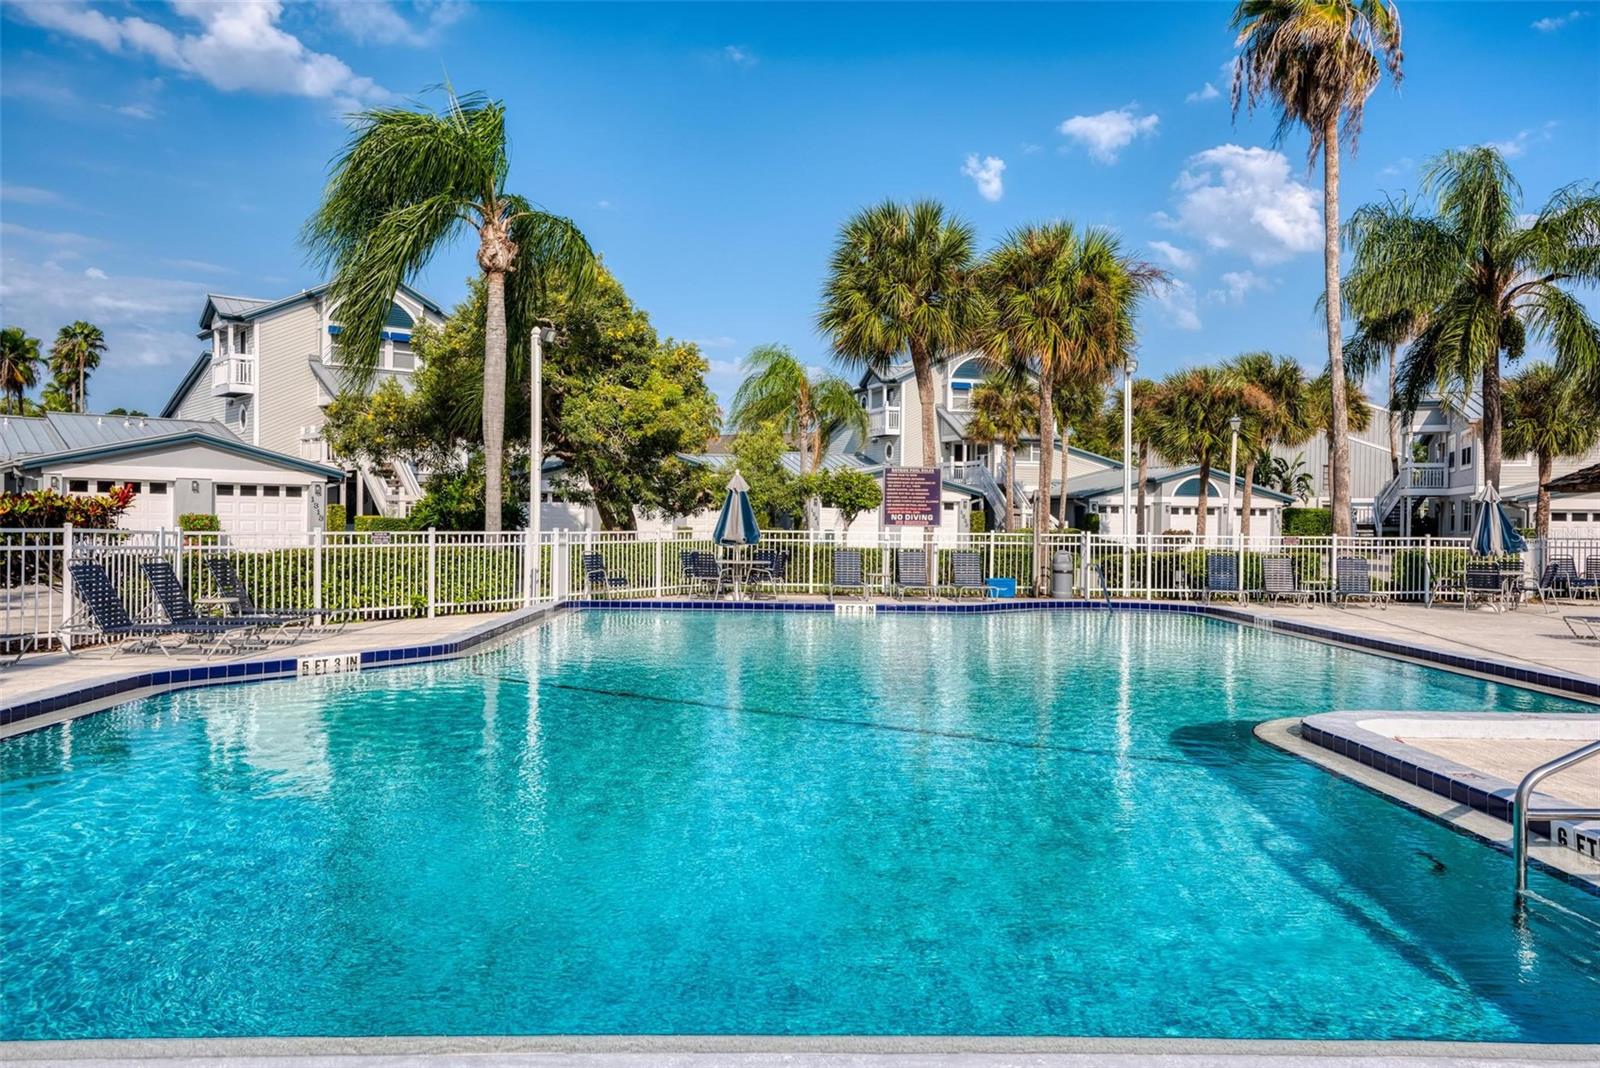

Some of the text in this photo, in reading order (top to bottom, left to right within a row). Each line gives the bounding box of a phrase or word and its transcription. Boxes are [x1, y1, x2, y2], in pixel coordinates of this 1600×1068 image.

[302, 656, 358, 676] 5 FT 3 IN
[1557, 827, 1597, 857] 6 FT
